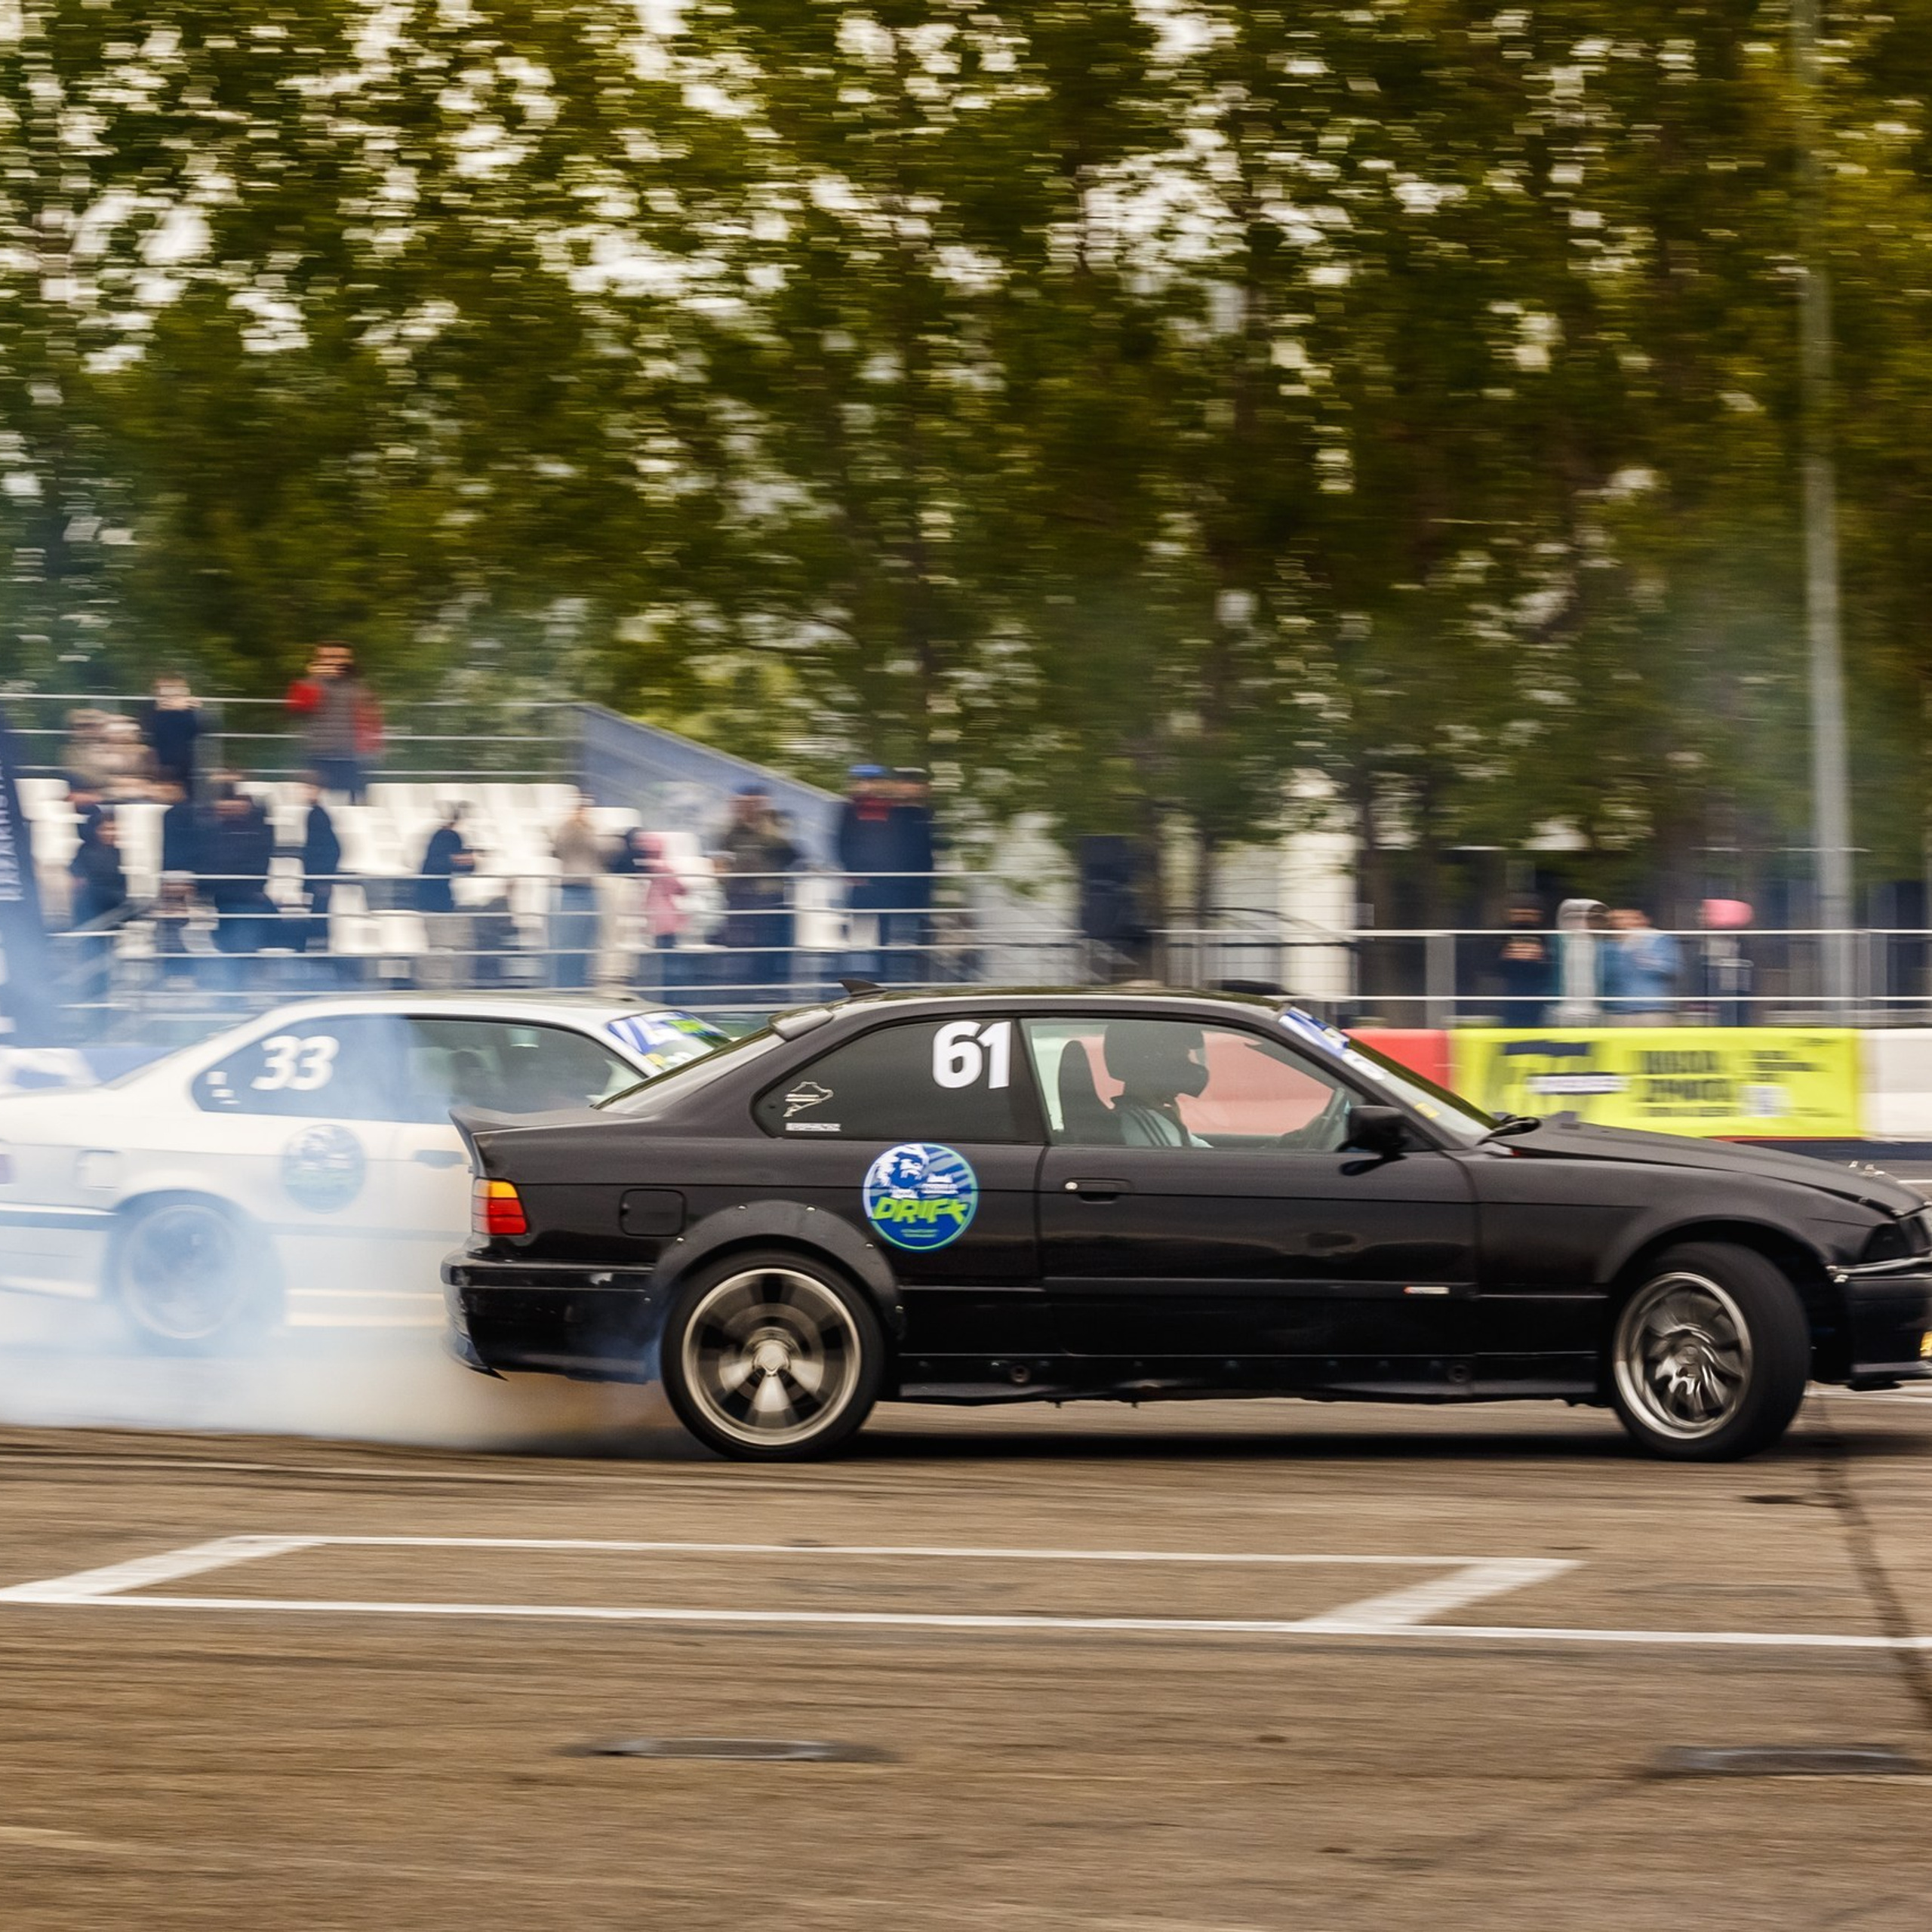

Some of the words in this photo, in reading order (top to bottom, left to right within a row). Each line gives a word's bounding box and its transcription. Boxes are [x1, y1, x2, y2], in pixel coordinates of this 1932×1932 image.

[251, 1035, 339, 1090] 33
[933, 1021, 1011, 1089] 61
[872, 1197, 968, 1223] DRIFT
